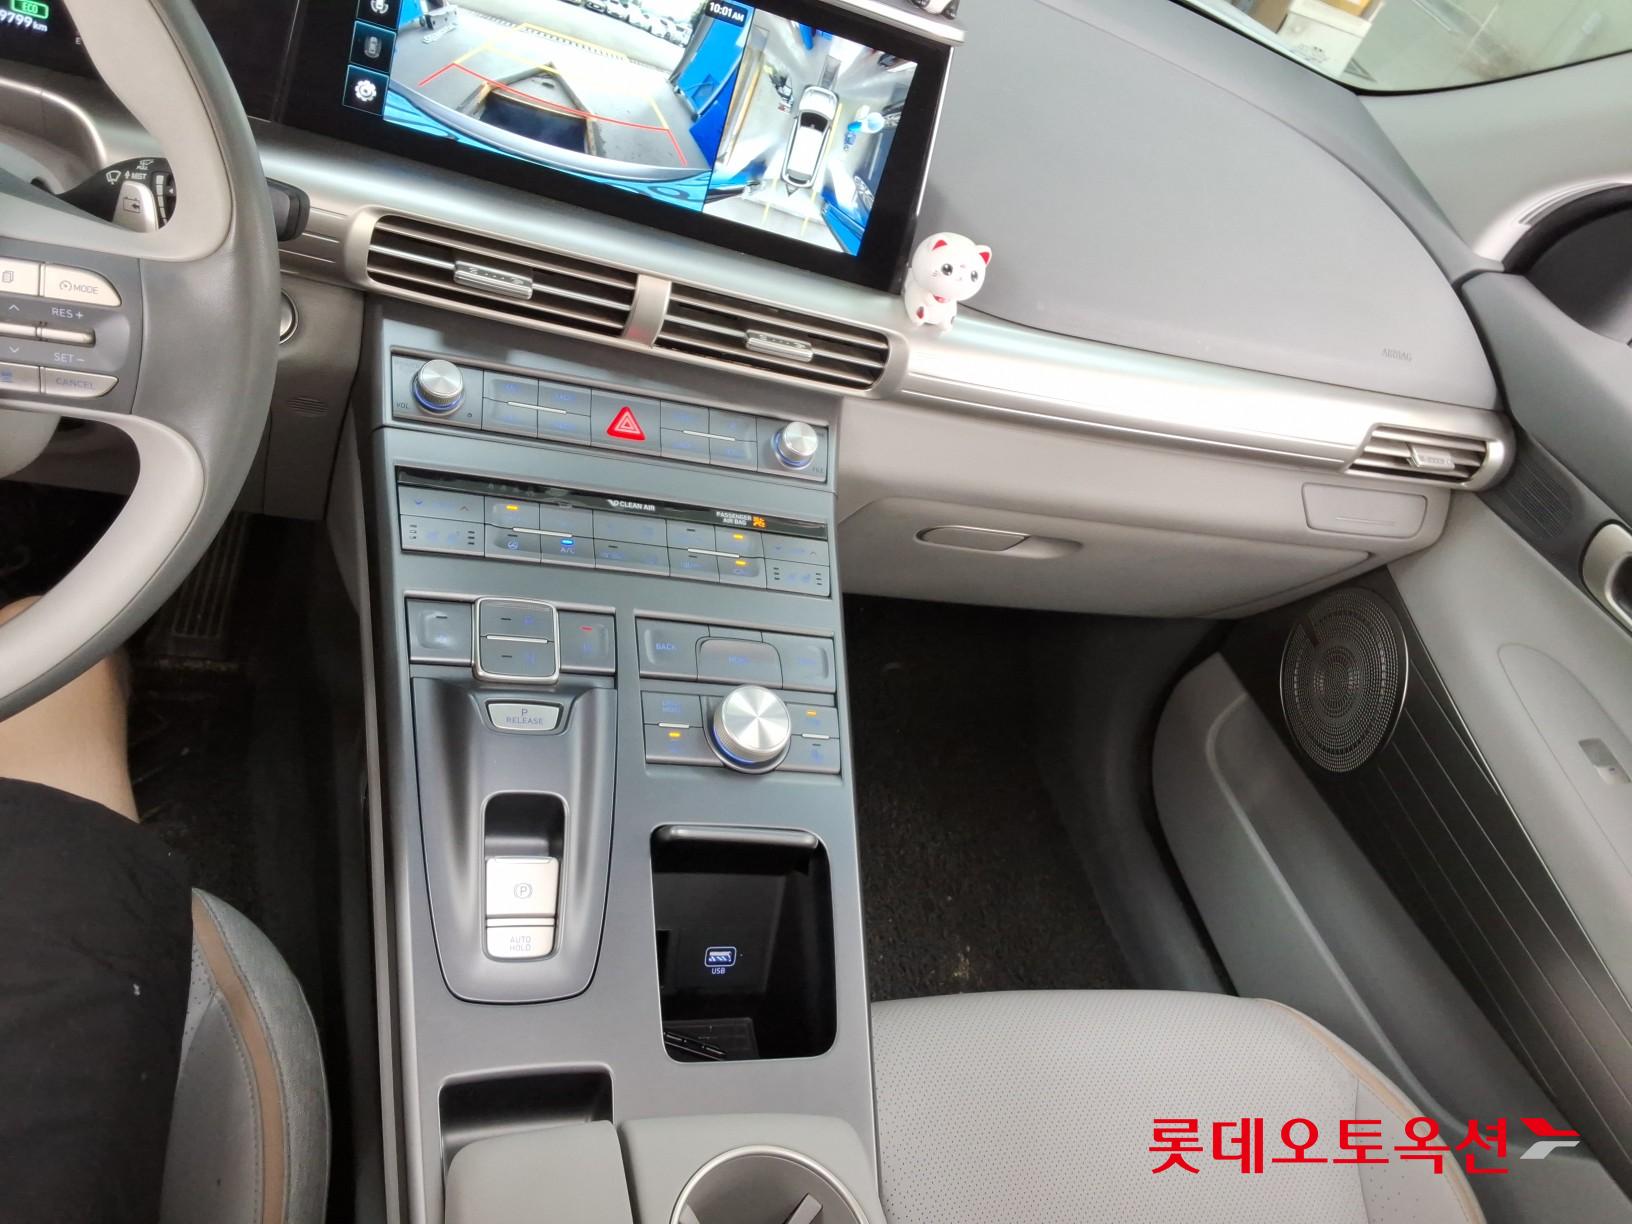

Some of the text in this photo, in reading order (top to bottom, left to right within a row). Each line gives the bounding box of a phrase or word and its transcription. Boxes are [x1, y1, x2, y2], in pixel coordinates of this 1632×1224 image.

[22, 3, 38, 14] ECO
[710, 2, 745, 22] 10:01 AM
[33, 21, 48, 32] km
[131, 172, 147, 180] MIST
[73, 284, 99, 295] MODE
[51, 306, 73, 319] RES
[54, 352, 74, 363] SET
[55, 377, 96, 391] CANCEL
[620, 500, 643, 510] CLEAN
[716, 511, 752, 521] PASSENGER
[521, 708, 528, 716] P
[505, 716, 544, 725] RELEASE
[510, 935, 532, 944] AUTO
[510, 944, 532, 952] HOLD
[711, 966, 726, 975] USB
